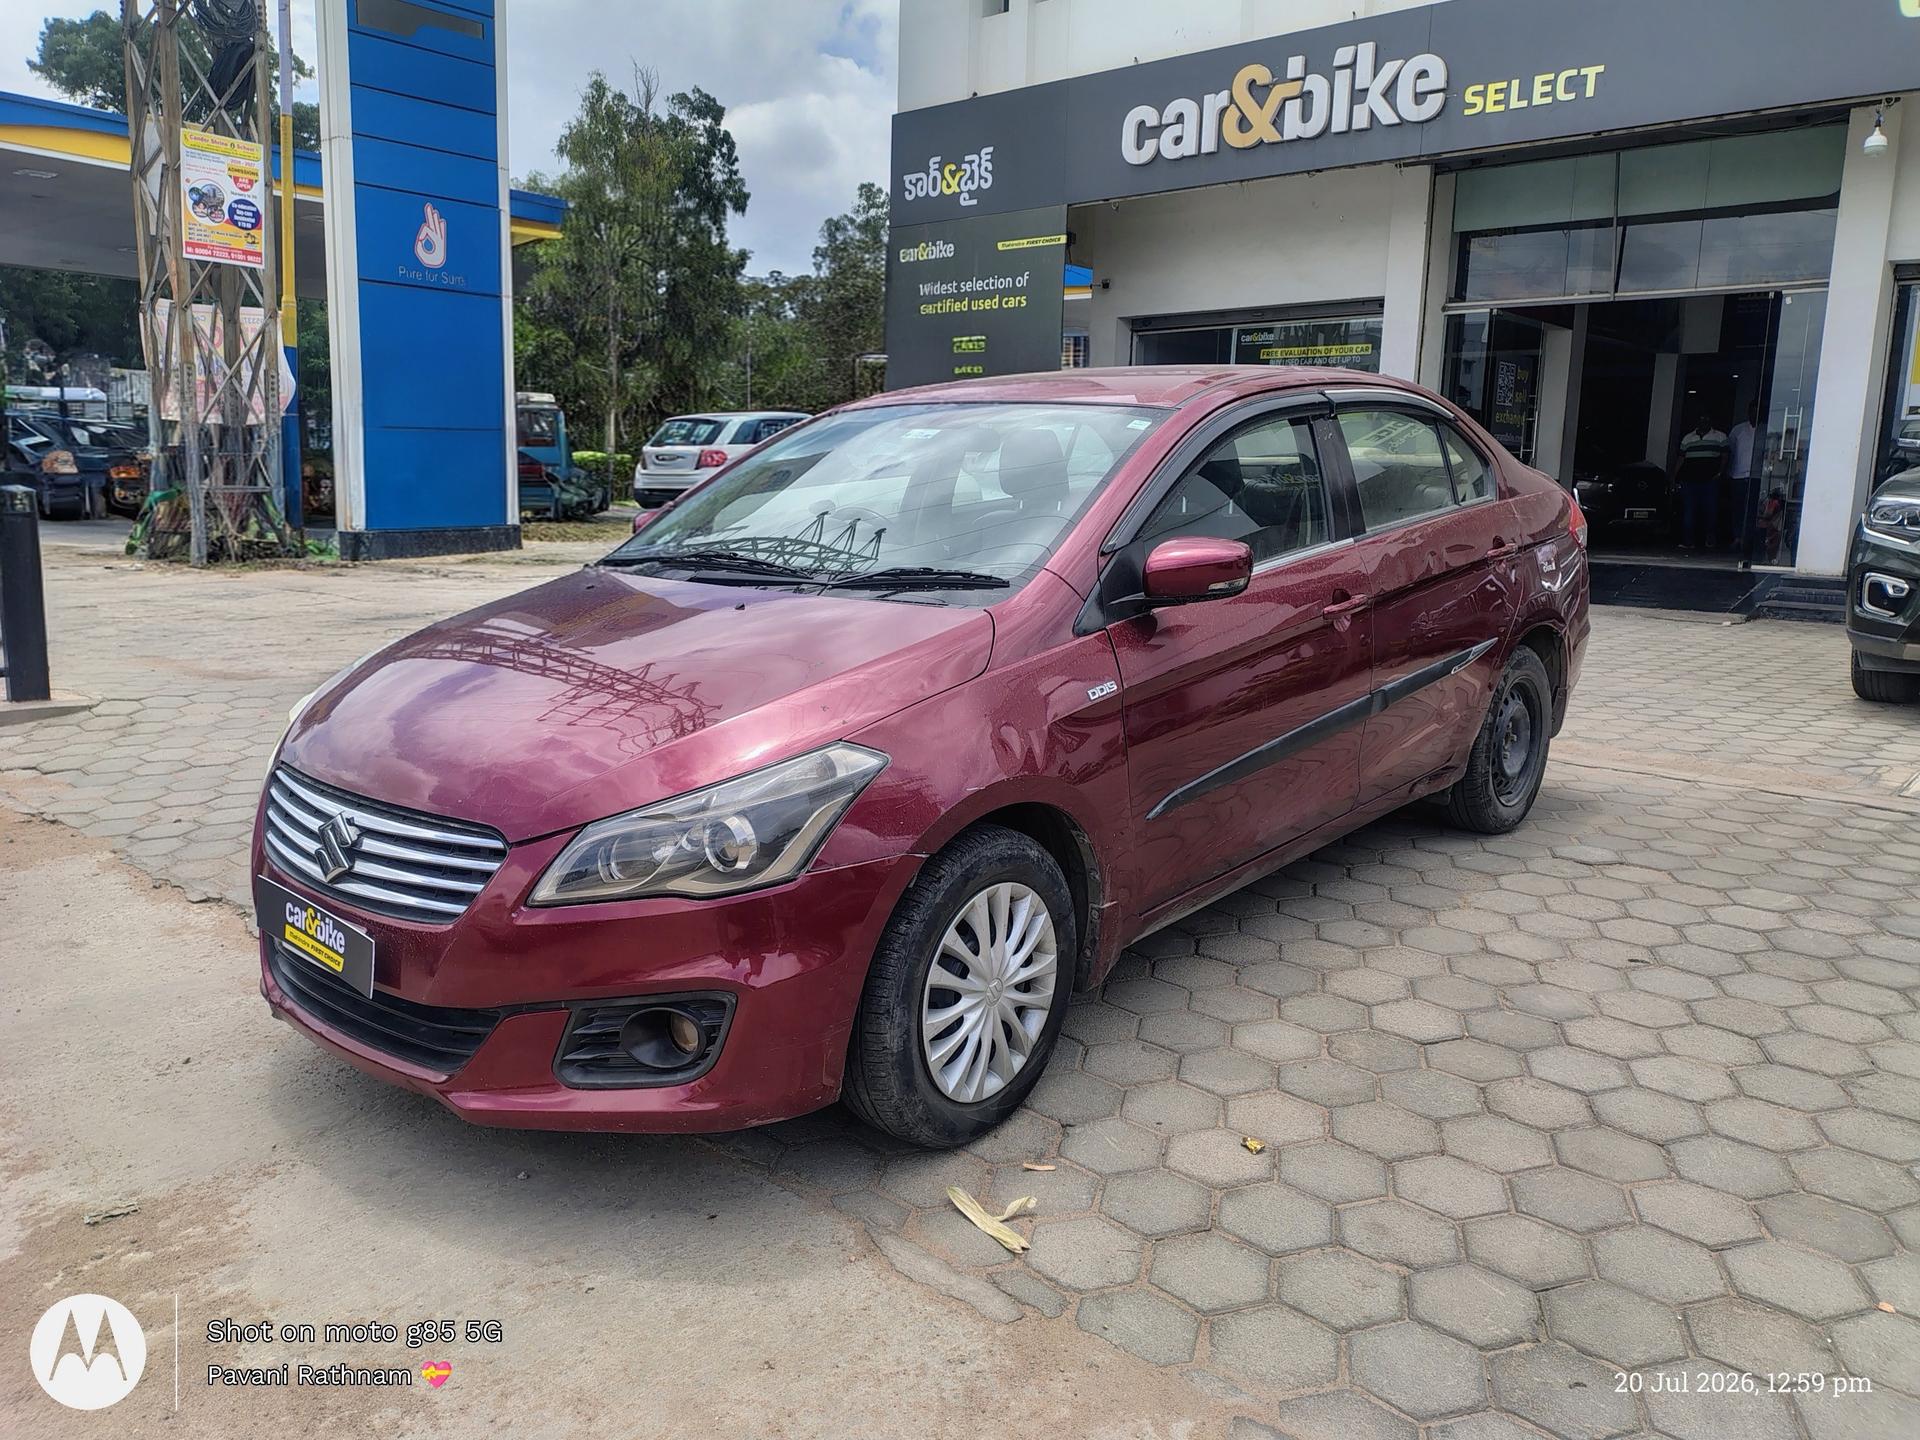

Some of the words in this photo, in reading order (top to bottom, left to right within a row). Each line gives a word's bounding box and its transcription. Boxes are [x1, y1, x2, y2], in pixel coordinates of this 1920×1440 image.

[1463, 64, 1605, 116] SELECT
[1121, 41, 1448, 166] car&bike
[899, 240, 955, 263] car&bike
[398, 265, 423, 281] Pure
[919, 280, 958, 296] Widest
[959, 275, 1013, 293] selection
[1015, 271, 1030, 288] of
[971, 294, 1000, 311] used
[1002, 295, 1027, 308] cars
[1280, 348, 1322, 357] EVALUATION
[1324, 347, 1334, 355] OF
[1334, 346, 1354, 354] YOUR
[1355, 345, 1370, 353] CAR
[1352, 355, 1361, 363] TO
[285, 902, 345, 954] car&bike
